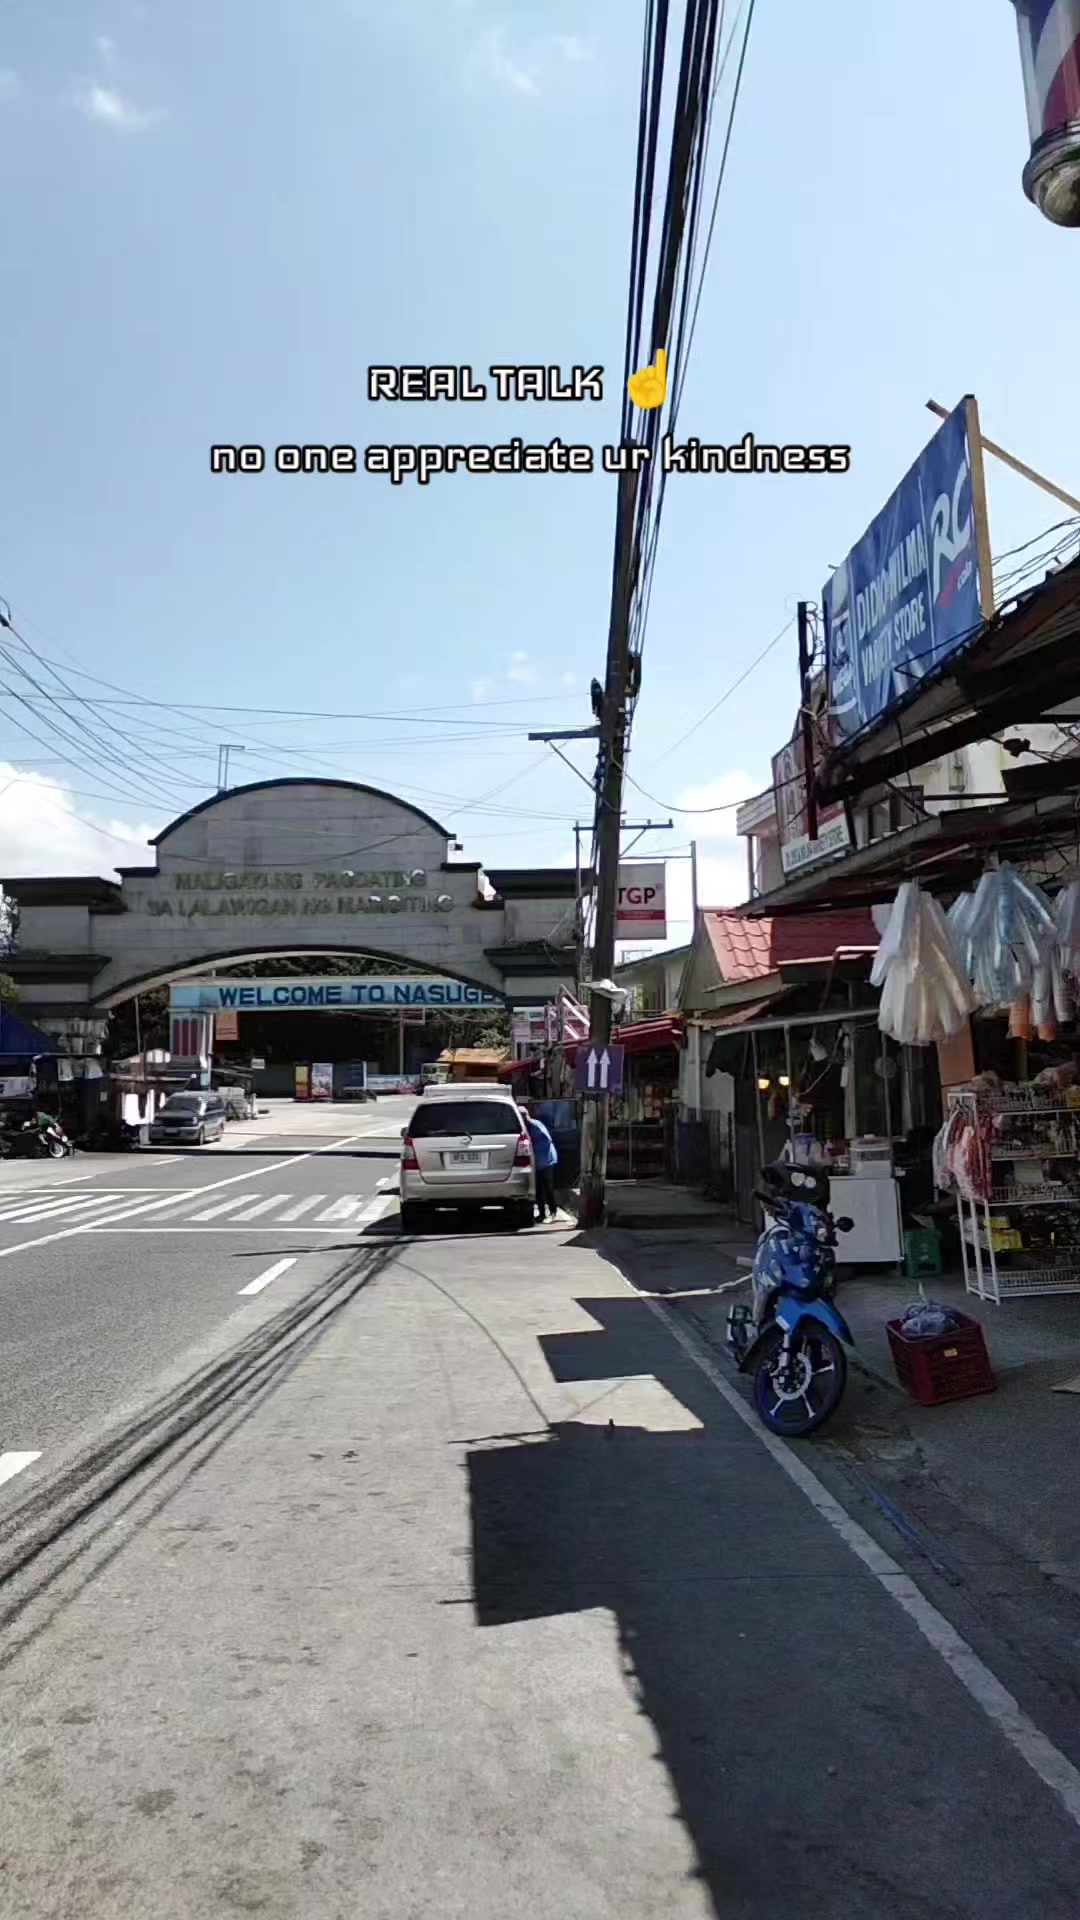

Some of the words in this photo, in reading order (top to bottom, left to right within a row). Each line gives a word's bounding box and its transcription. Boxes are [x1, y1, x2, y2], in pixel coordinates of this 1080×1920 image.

[894, 591, 926, 650] STORE
[617, 886, 656, 905] TGP
[219, 985, 342, 1005] WELCOME
[352, 985, 385, 1003] TO
